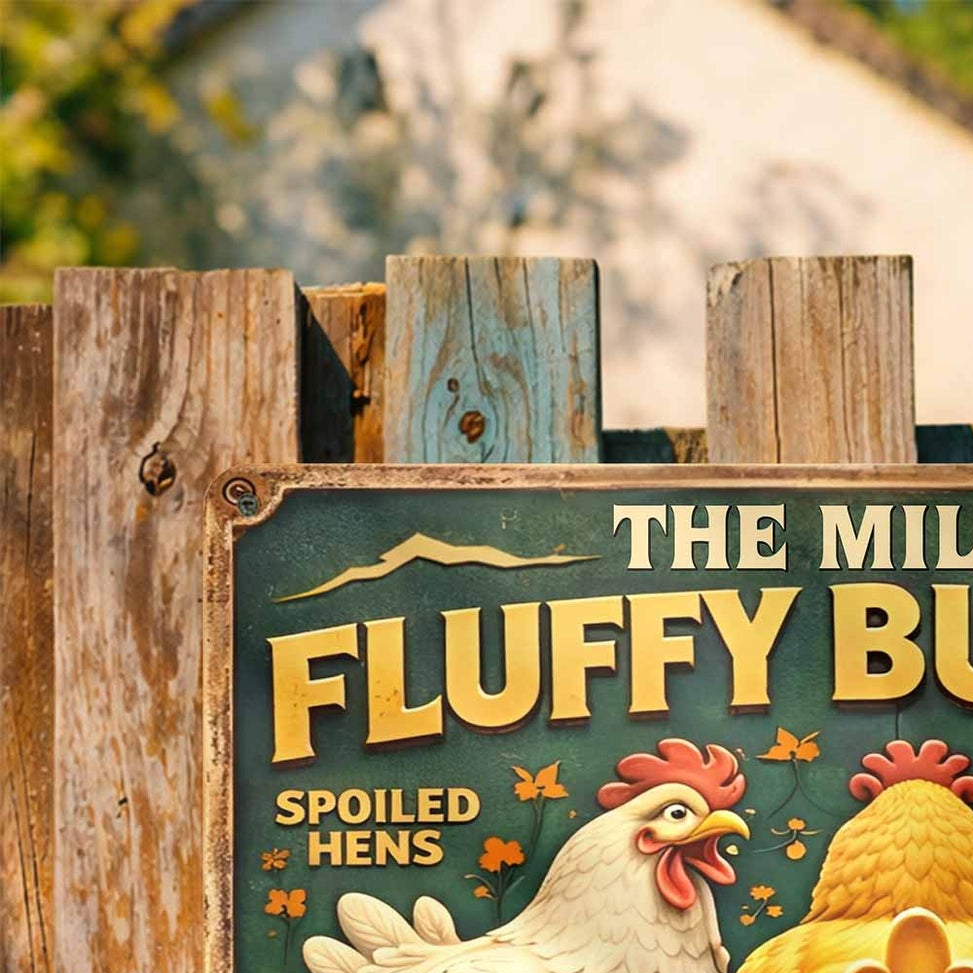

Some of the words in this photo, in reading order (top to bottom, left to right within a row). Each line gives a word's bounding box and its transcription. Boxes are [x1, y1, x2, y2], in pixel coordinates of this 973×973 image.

[612, 503, 790, 572] THE
[265, 586, 803, 766] FLUFFY
[274, 786, 482, 826] SPOILED
[306, 829, 445, 868] HENS
